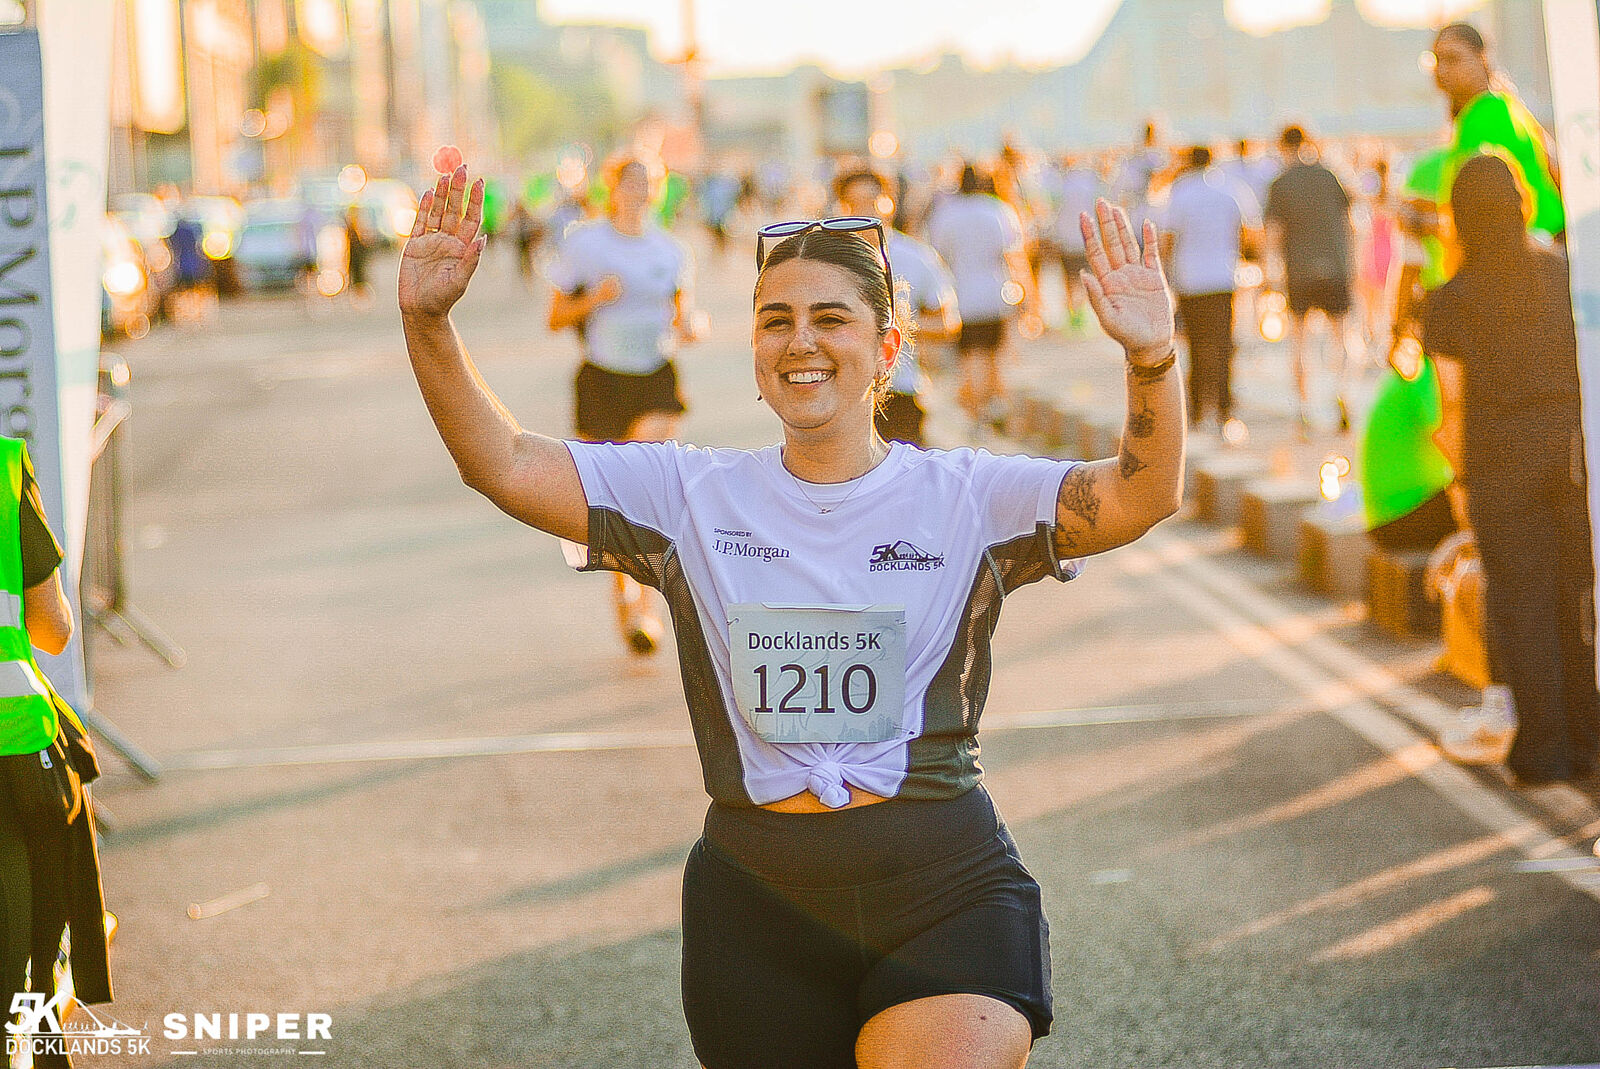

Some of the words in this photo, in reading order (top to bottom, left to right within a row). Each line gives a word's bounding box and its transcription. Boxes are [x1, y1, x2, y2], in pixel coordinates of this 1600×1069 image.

[713, 527, 745, 537] SPONSORED
[712, 539, 790, 562] J.P.Morgan
[868, 540, 902, 563] 5K
[869, 561, 931, 572] DOCKLANDS
[933, 558, 945, 570] 5K
[748, 632, 849, 650] Docklands
[855, 632, 881, 650] 5K
[753, 663, 877, 714] 1210
